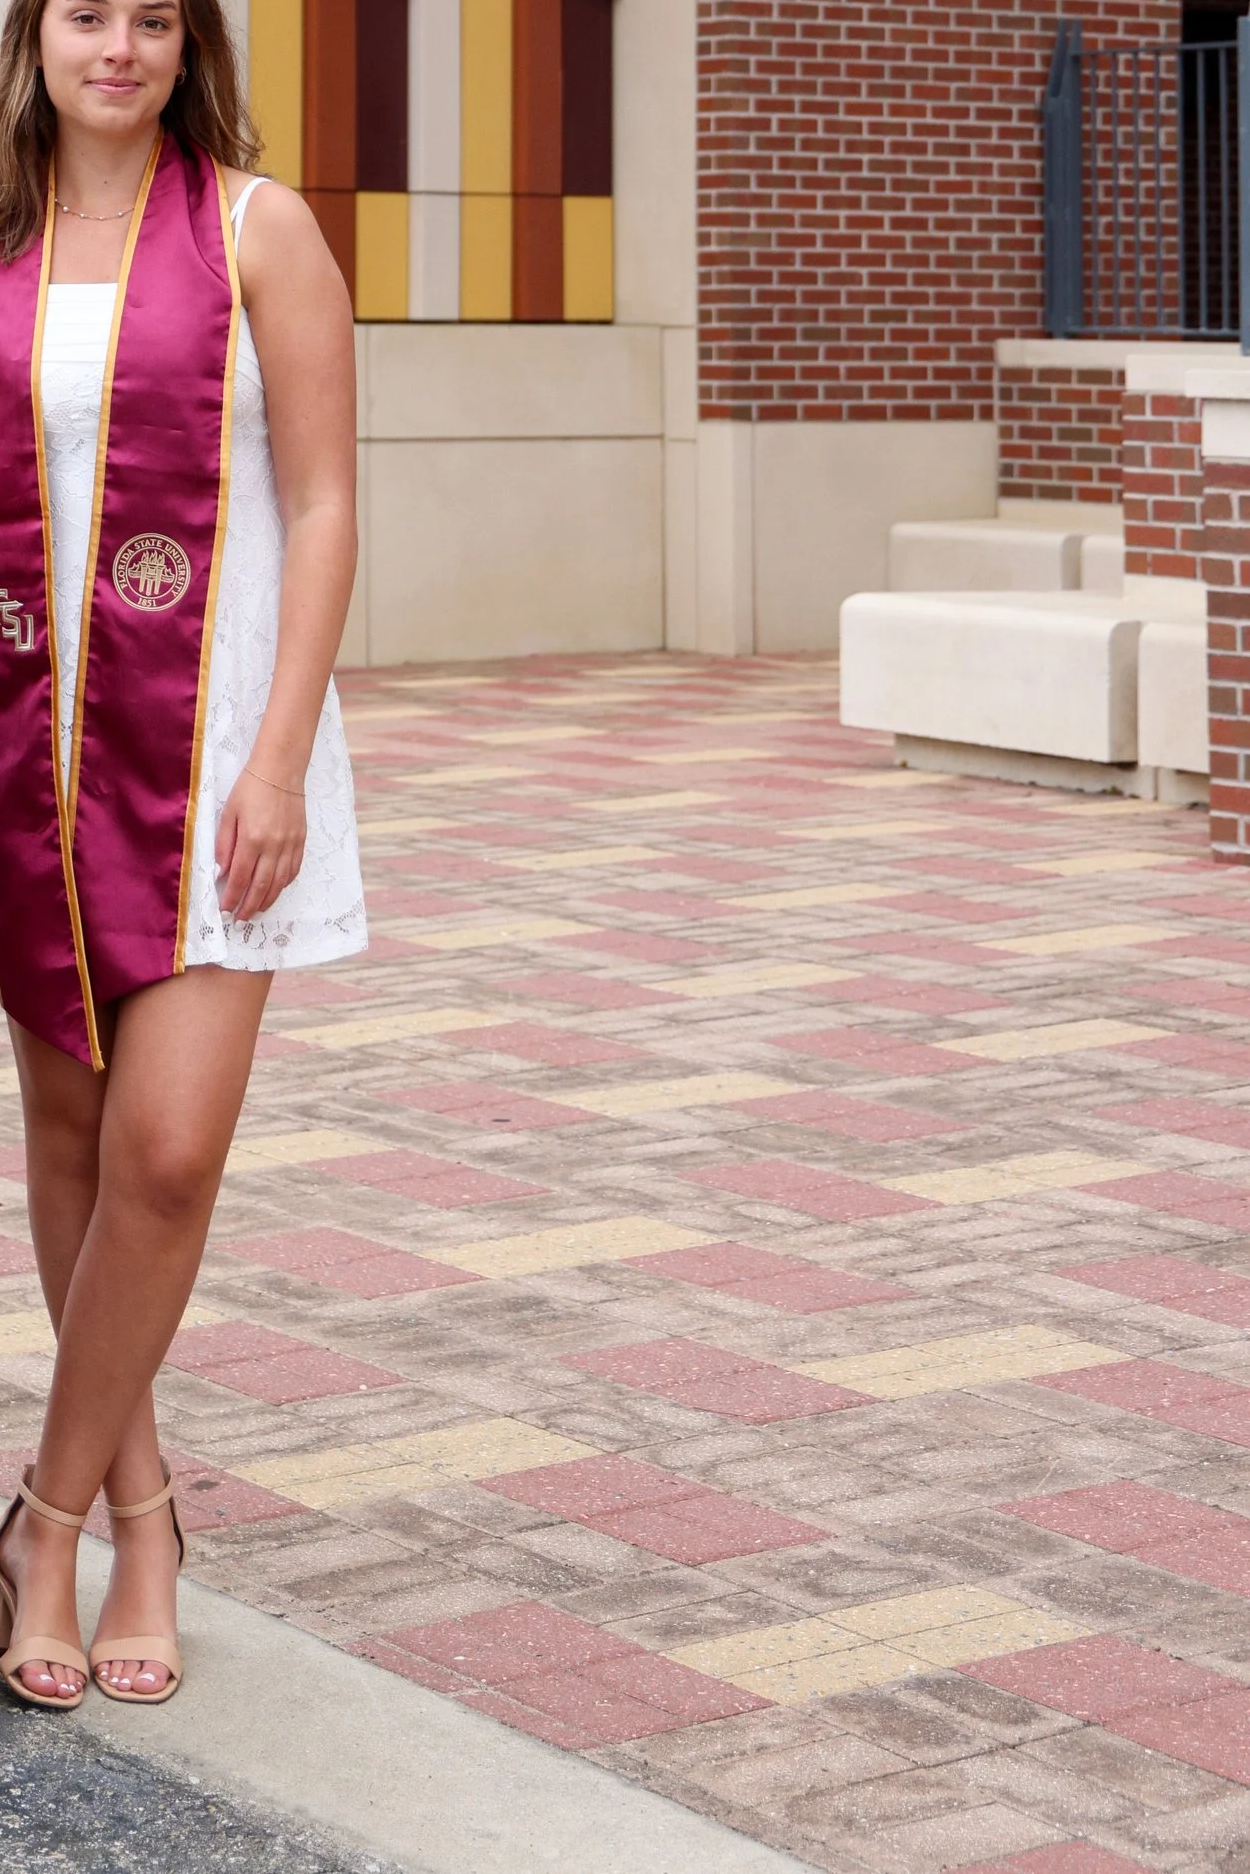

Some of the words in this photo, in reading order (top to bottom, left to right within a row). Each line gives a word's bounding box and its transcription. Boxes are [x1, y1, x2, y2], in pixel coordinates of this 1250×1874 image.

[118, 548, 134, 589] FLORIDA
[134, 538, 163, 550] STATE
[164, 543, 186, 597] UNIVERSITY
[137, 598, 157, 607] 1851
